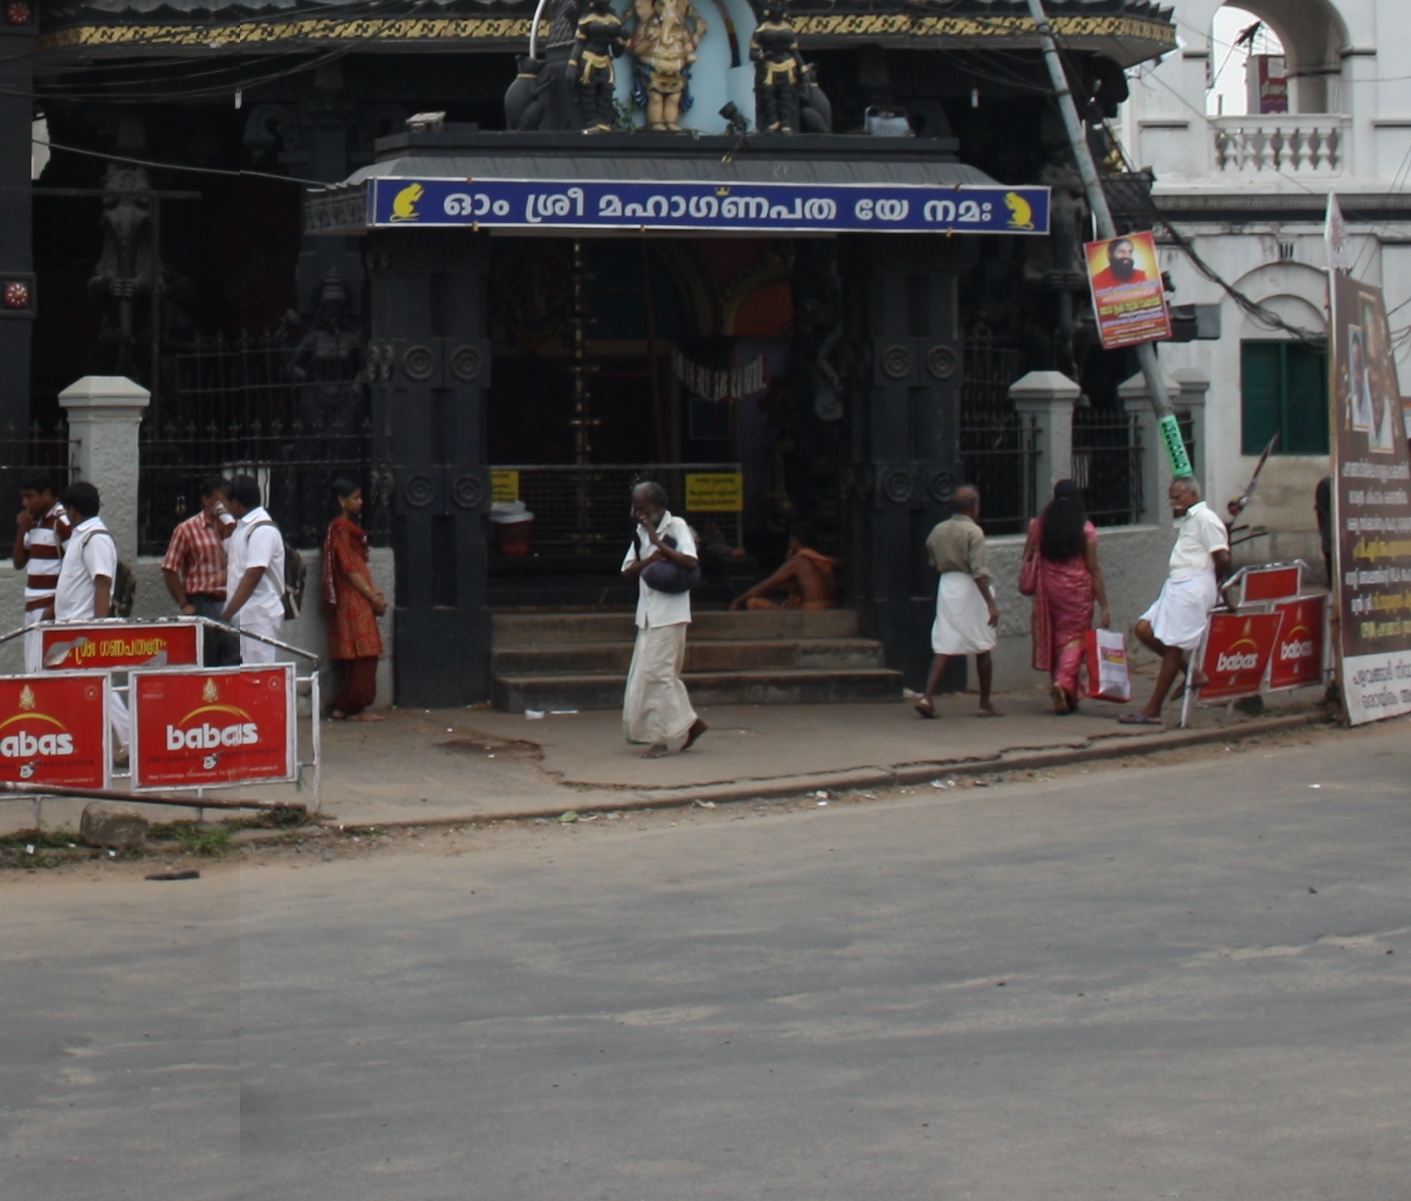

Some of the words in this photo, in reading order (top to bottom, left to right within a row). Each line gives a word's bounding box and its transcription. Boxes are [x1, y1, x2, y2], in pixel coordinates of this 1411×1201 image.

[443, 191, 510, 218] ഓം
[526, 186, 584, 224] ശ്രീ
[1216, 651, 1259, 672] babas
[1280, 639, 1313, 660] babas
[165, 722, 259, 751] babas
